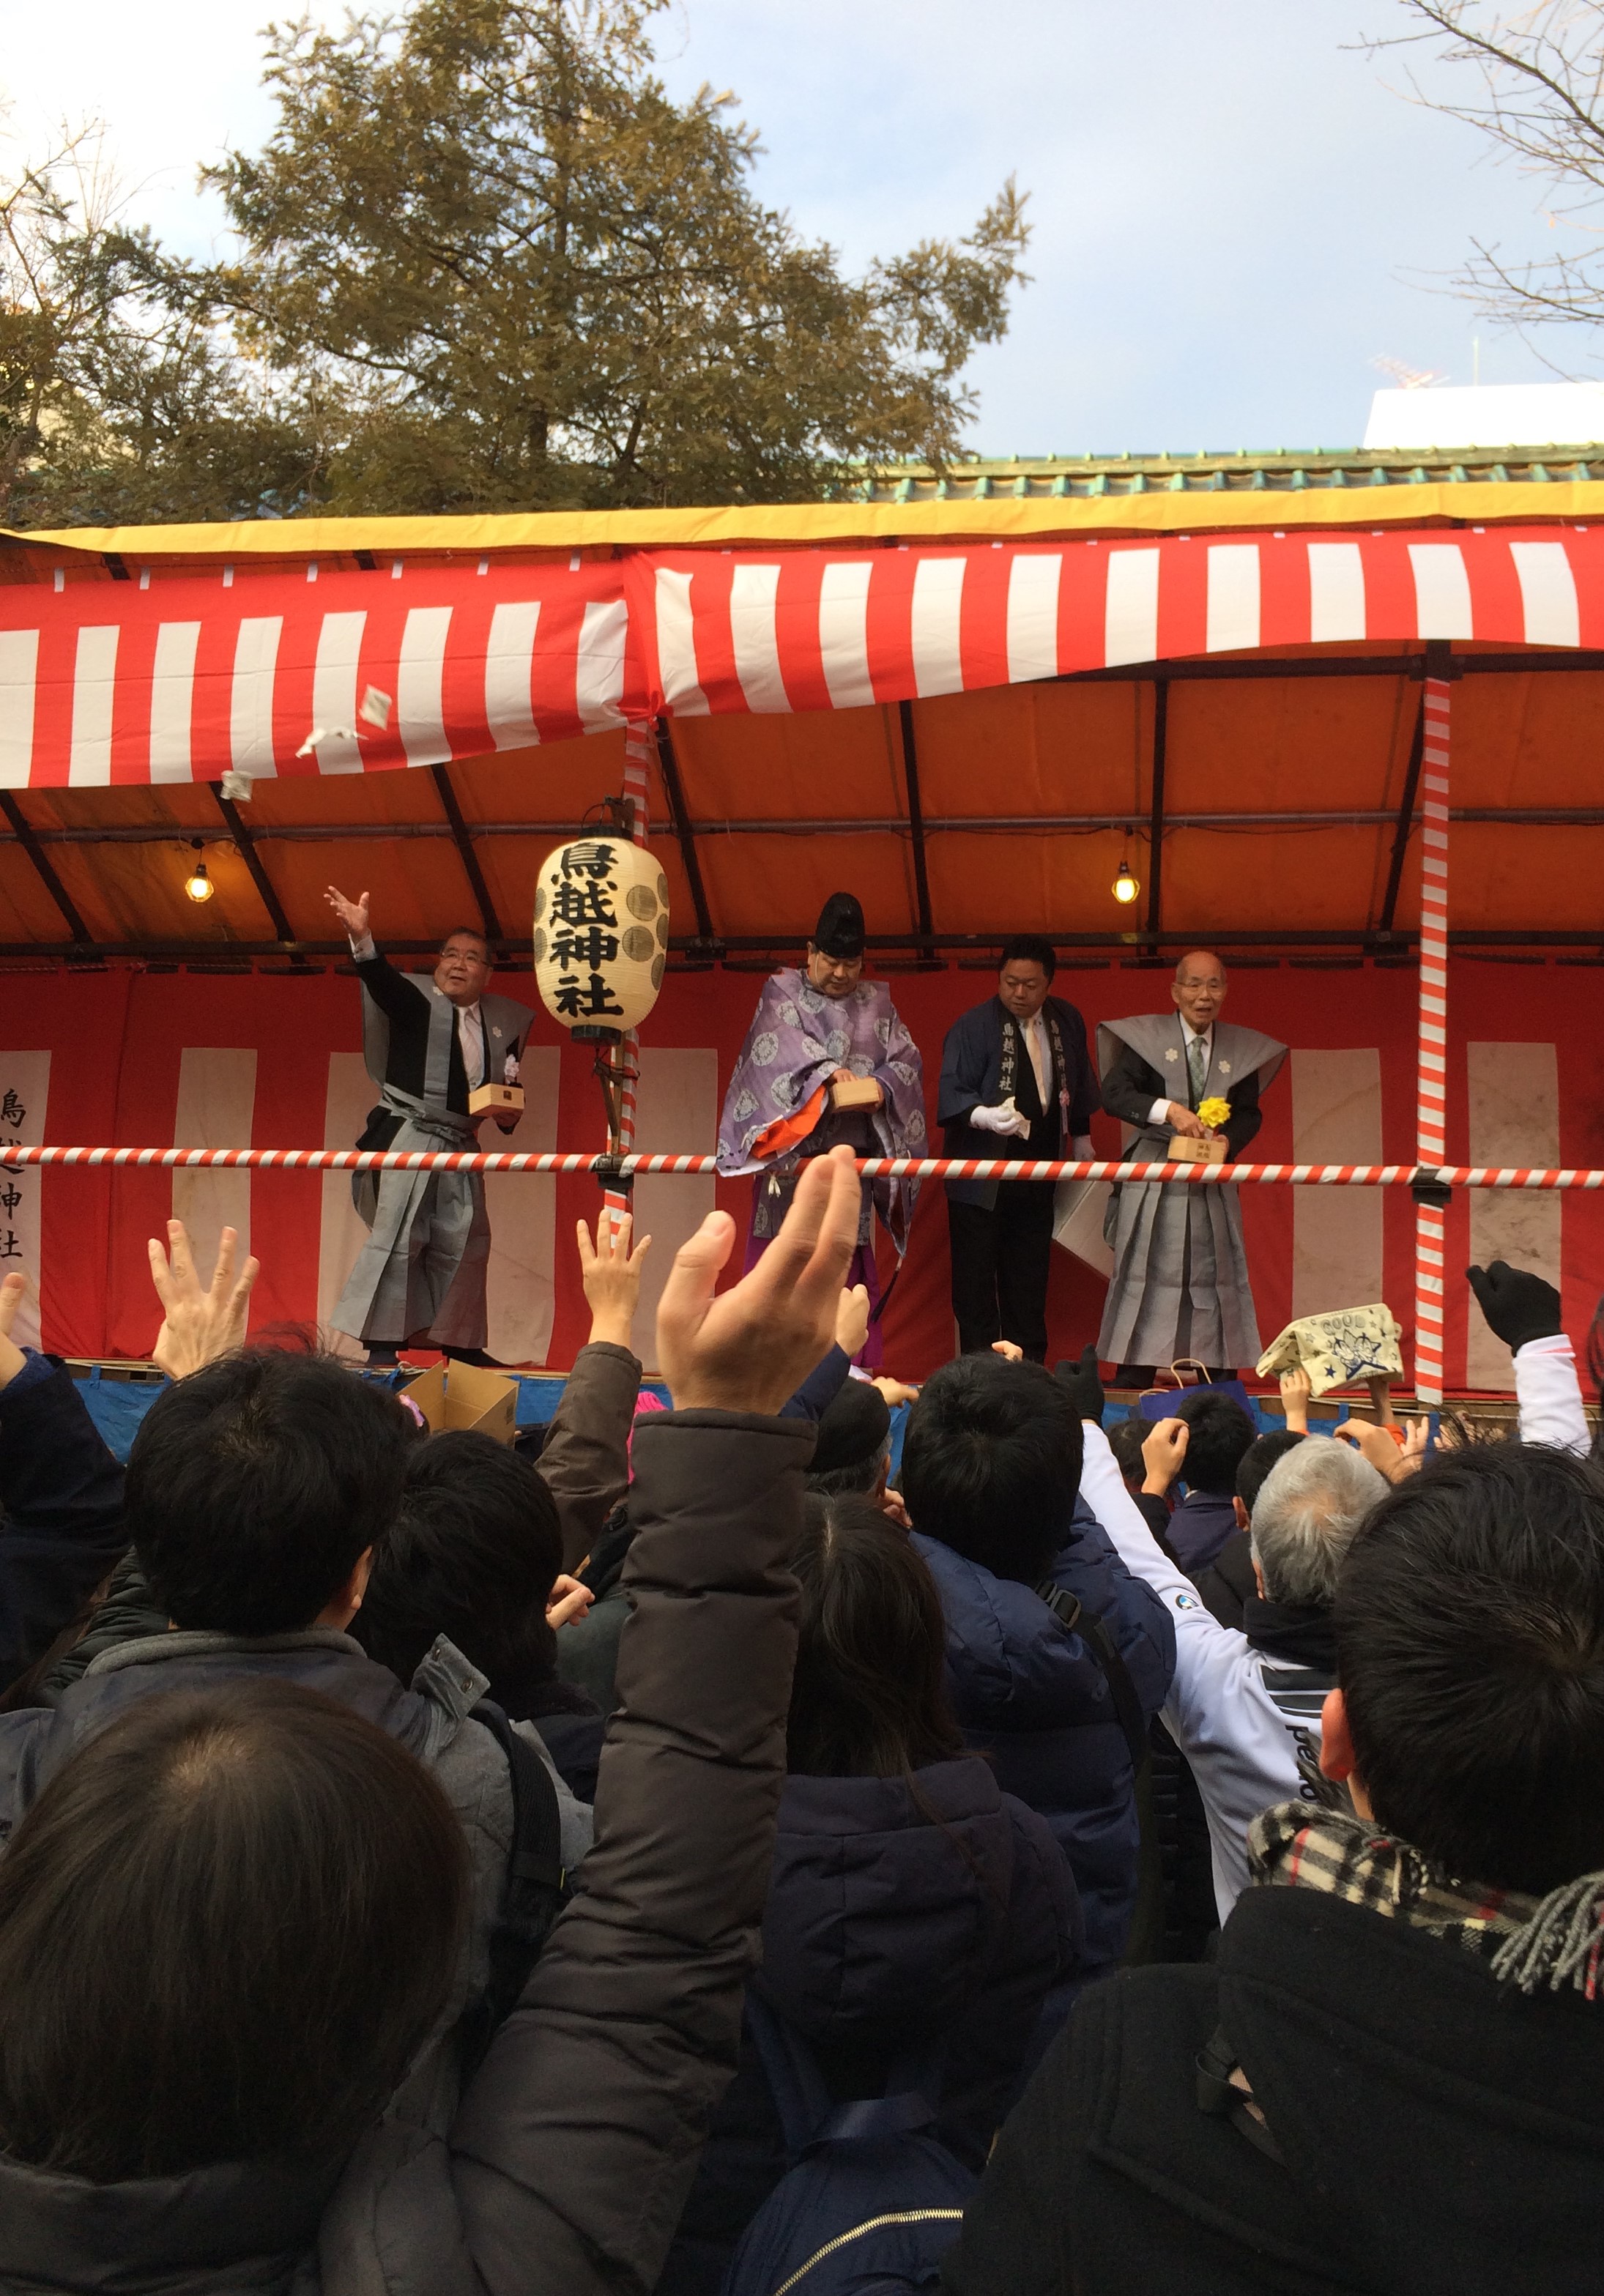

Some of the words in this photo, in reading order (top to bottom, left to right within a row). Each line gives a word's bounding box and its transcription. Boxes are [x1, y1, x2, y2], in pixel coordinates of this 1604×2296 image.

[549, 842, 624, 1017] 鳥越神社
[998, 1022, 1014, 1091] 鳥越神社
